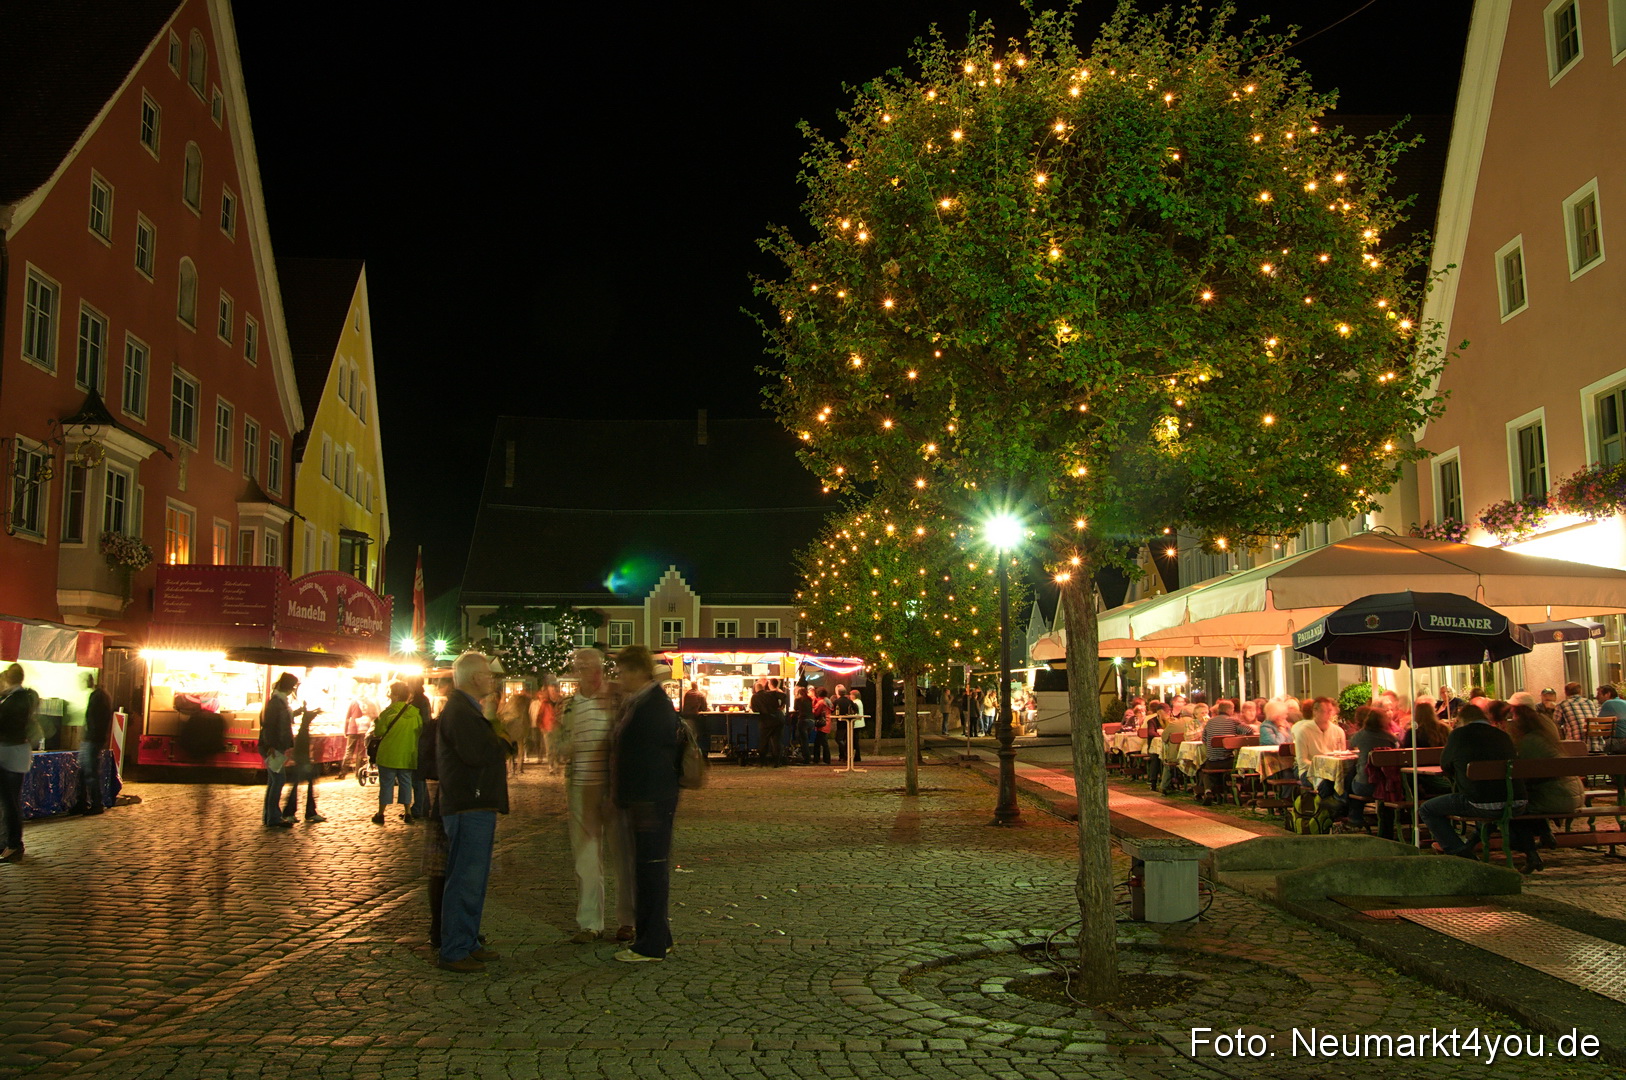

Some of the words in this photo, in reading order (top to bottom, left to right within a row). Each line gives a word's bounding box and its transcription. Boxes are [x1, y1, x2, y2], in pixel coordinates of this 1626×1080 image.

[287, 599, 326, 622] Mandeln
[344, 611, 383, 632] Magenbrot
[1429, 614, 1493, 630] PAULANER
